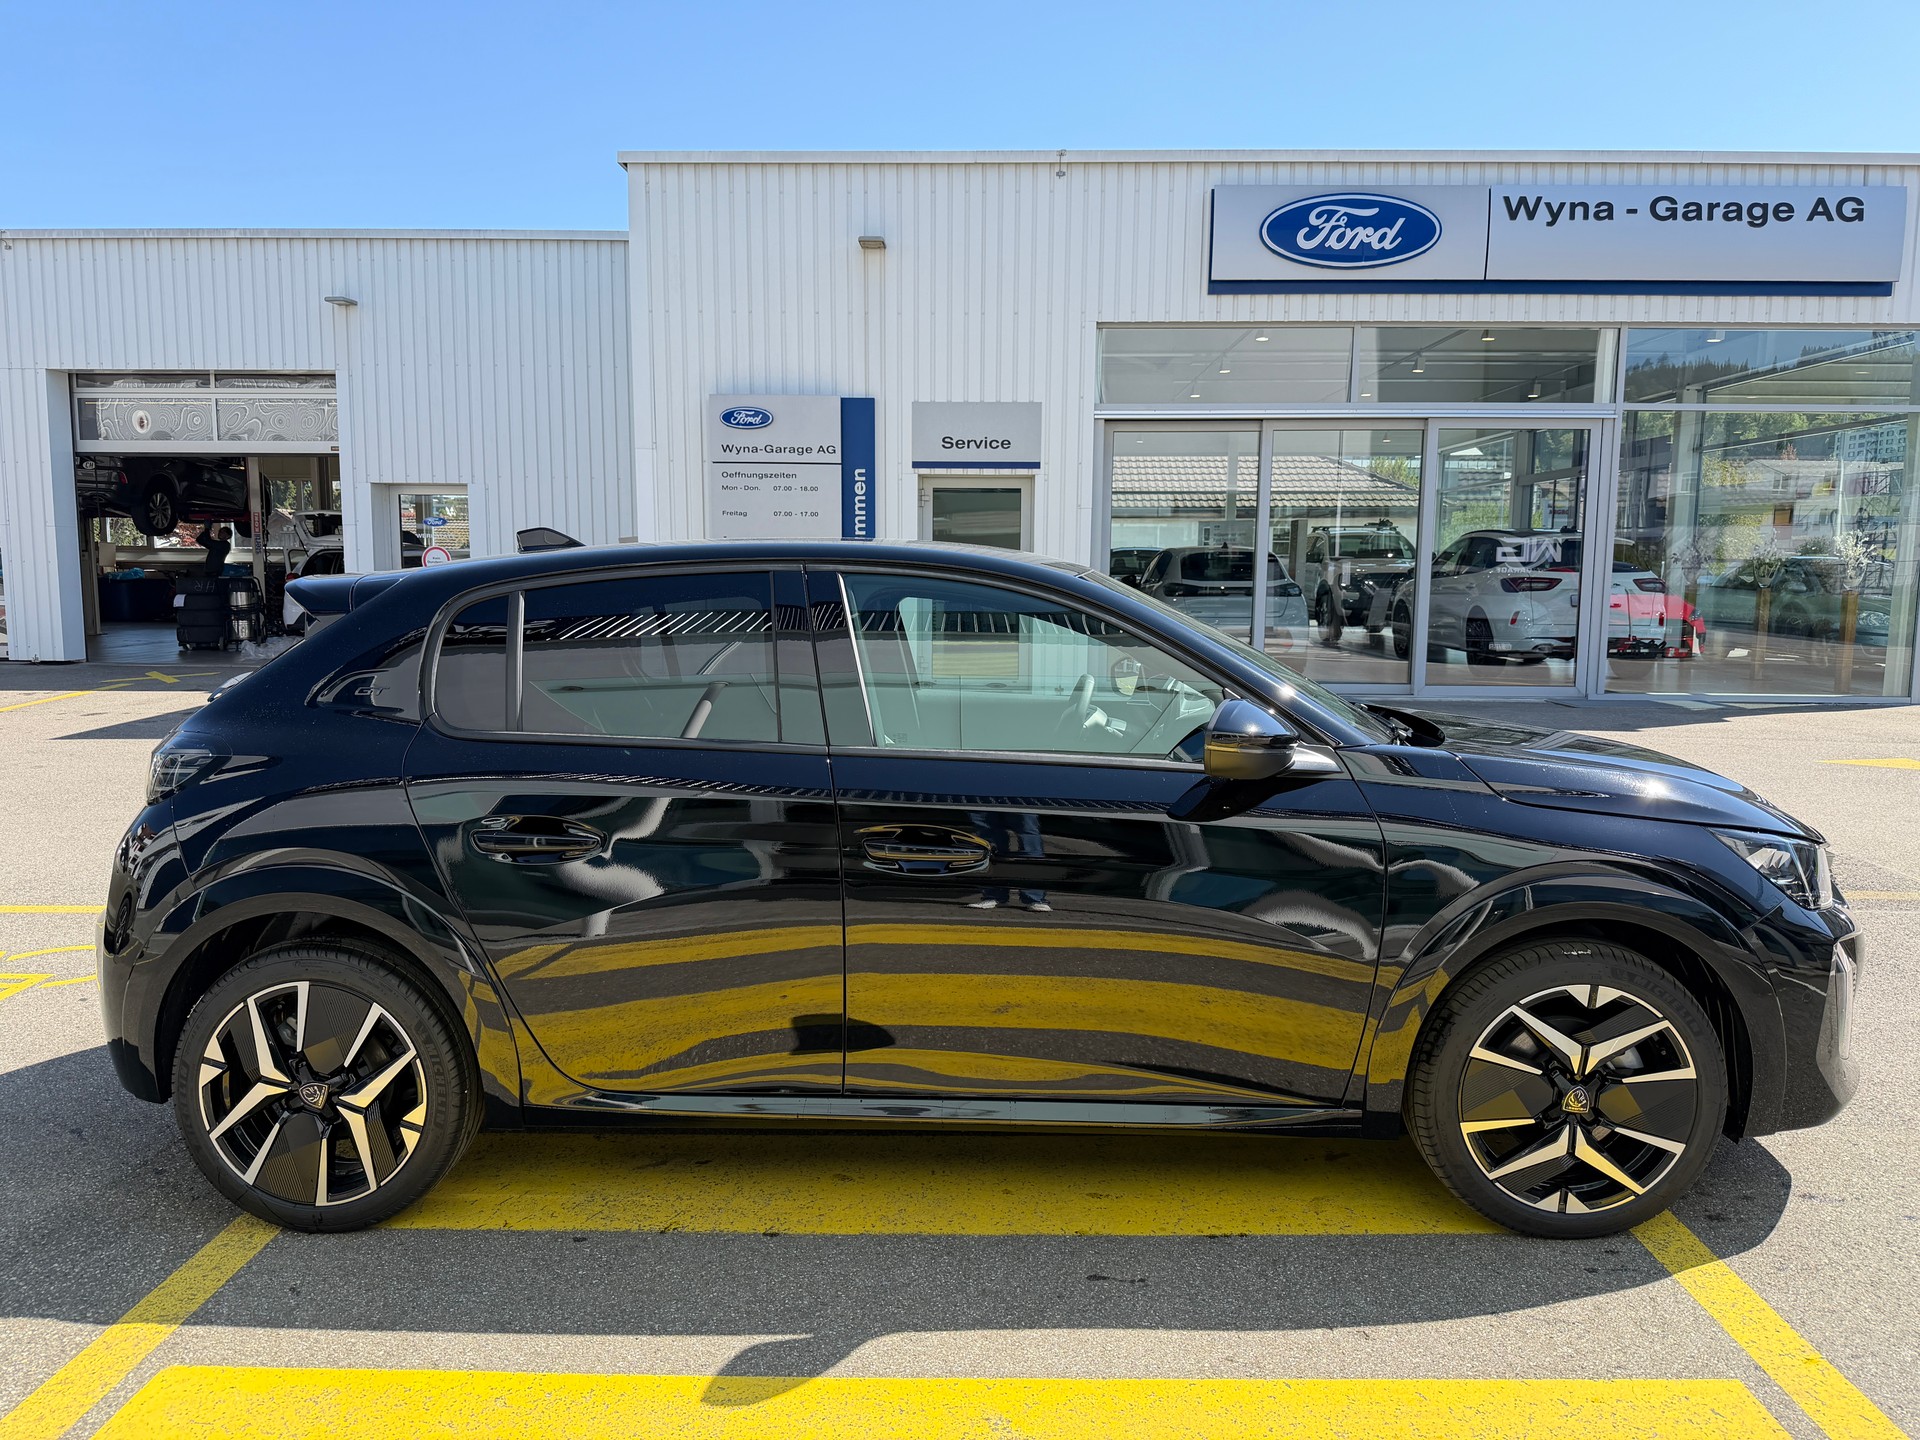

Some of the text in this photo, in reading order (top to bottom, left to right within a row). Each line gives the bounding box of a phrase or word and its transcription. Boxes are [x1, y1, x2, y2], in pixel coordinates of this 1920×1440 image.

[1503, 195, 1615, 228] Wyna
[1649, 195, 1795, 229] Garage
[1805, 196, 1866, 223] AG
[1296, 205, 1406, 250] Ford
[730, 410, 763, 425] Ford
[721, 444, 837, 456] Wyna-Garage AG
[941, 435, 1012, 450] Service
[721, 471, 797, 480] Oeffnungszeiten
[721, 510, 748, 518] Freitag
[854, 468, 867, 540] mmen
[1633, 973, 1703, 1036] MICHELIN
[426, 1042, 447, 1128] MICHELIN
